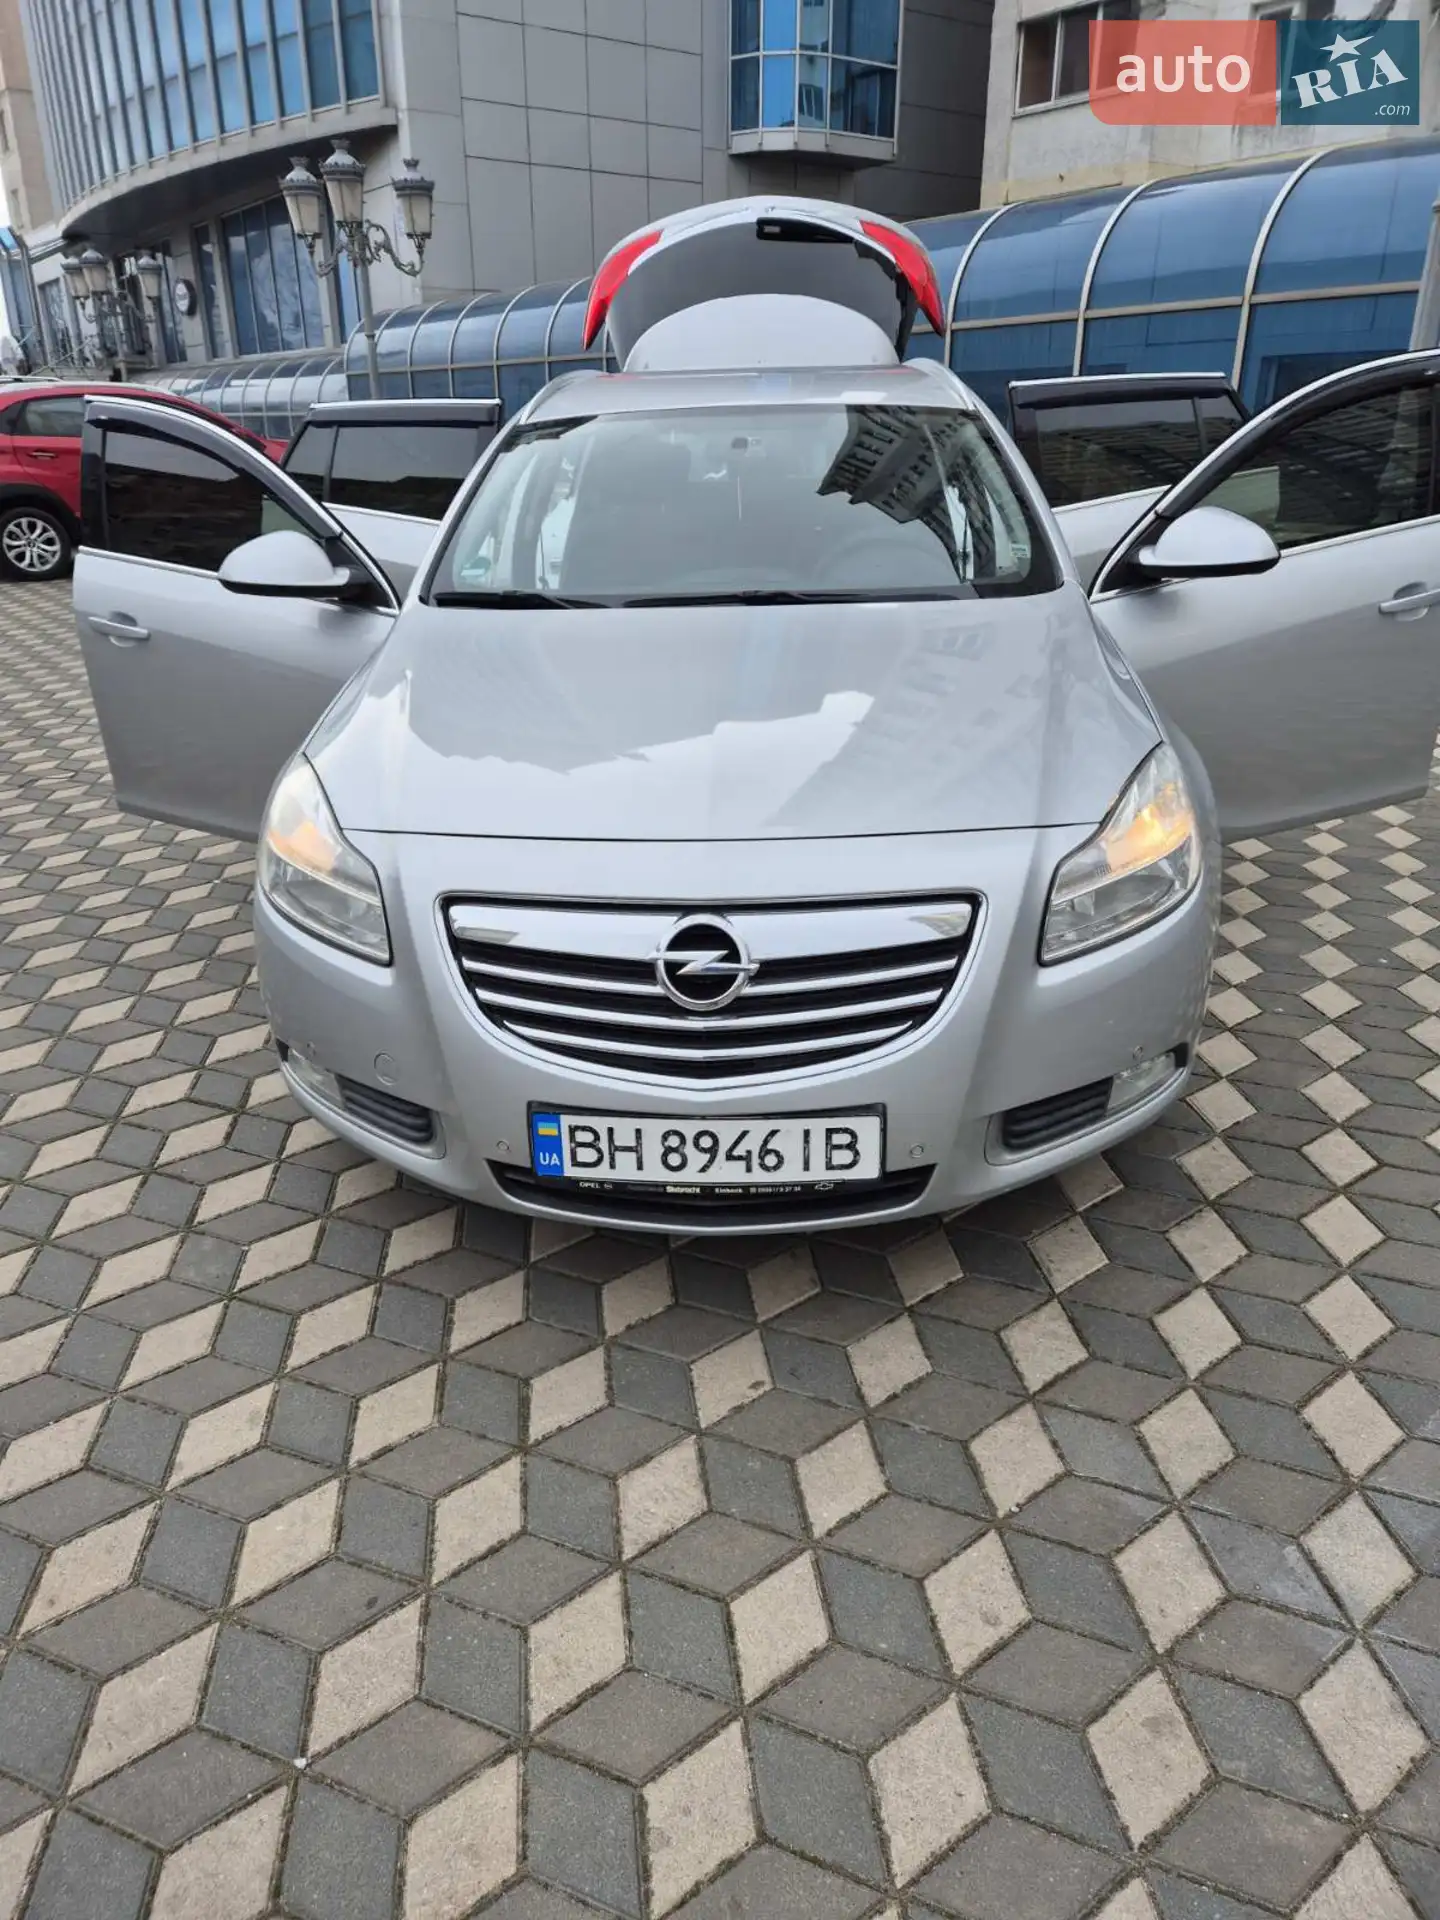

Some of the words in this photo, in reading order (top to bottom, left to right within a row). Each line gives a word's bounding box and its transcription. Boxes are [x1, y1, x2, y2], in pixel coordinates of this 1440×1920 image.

[568, 1124, 644, 1171] BH
[660, 1128, 785, 1173] 8946
[802, 1126, 861, 1172] IB
[539, 1151, 561, 1166] UA
[579, 1181, 601, 1189] OPEL
